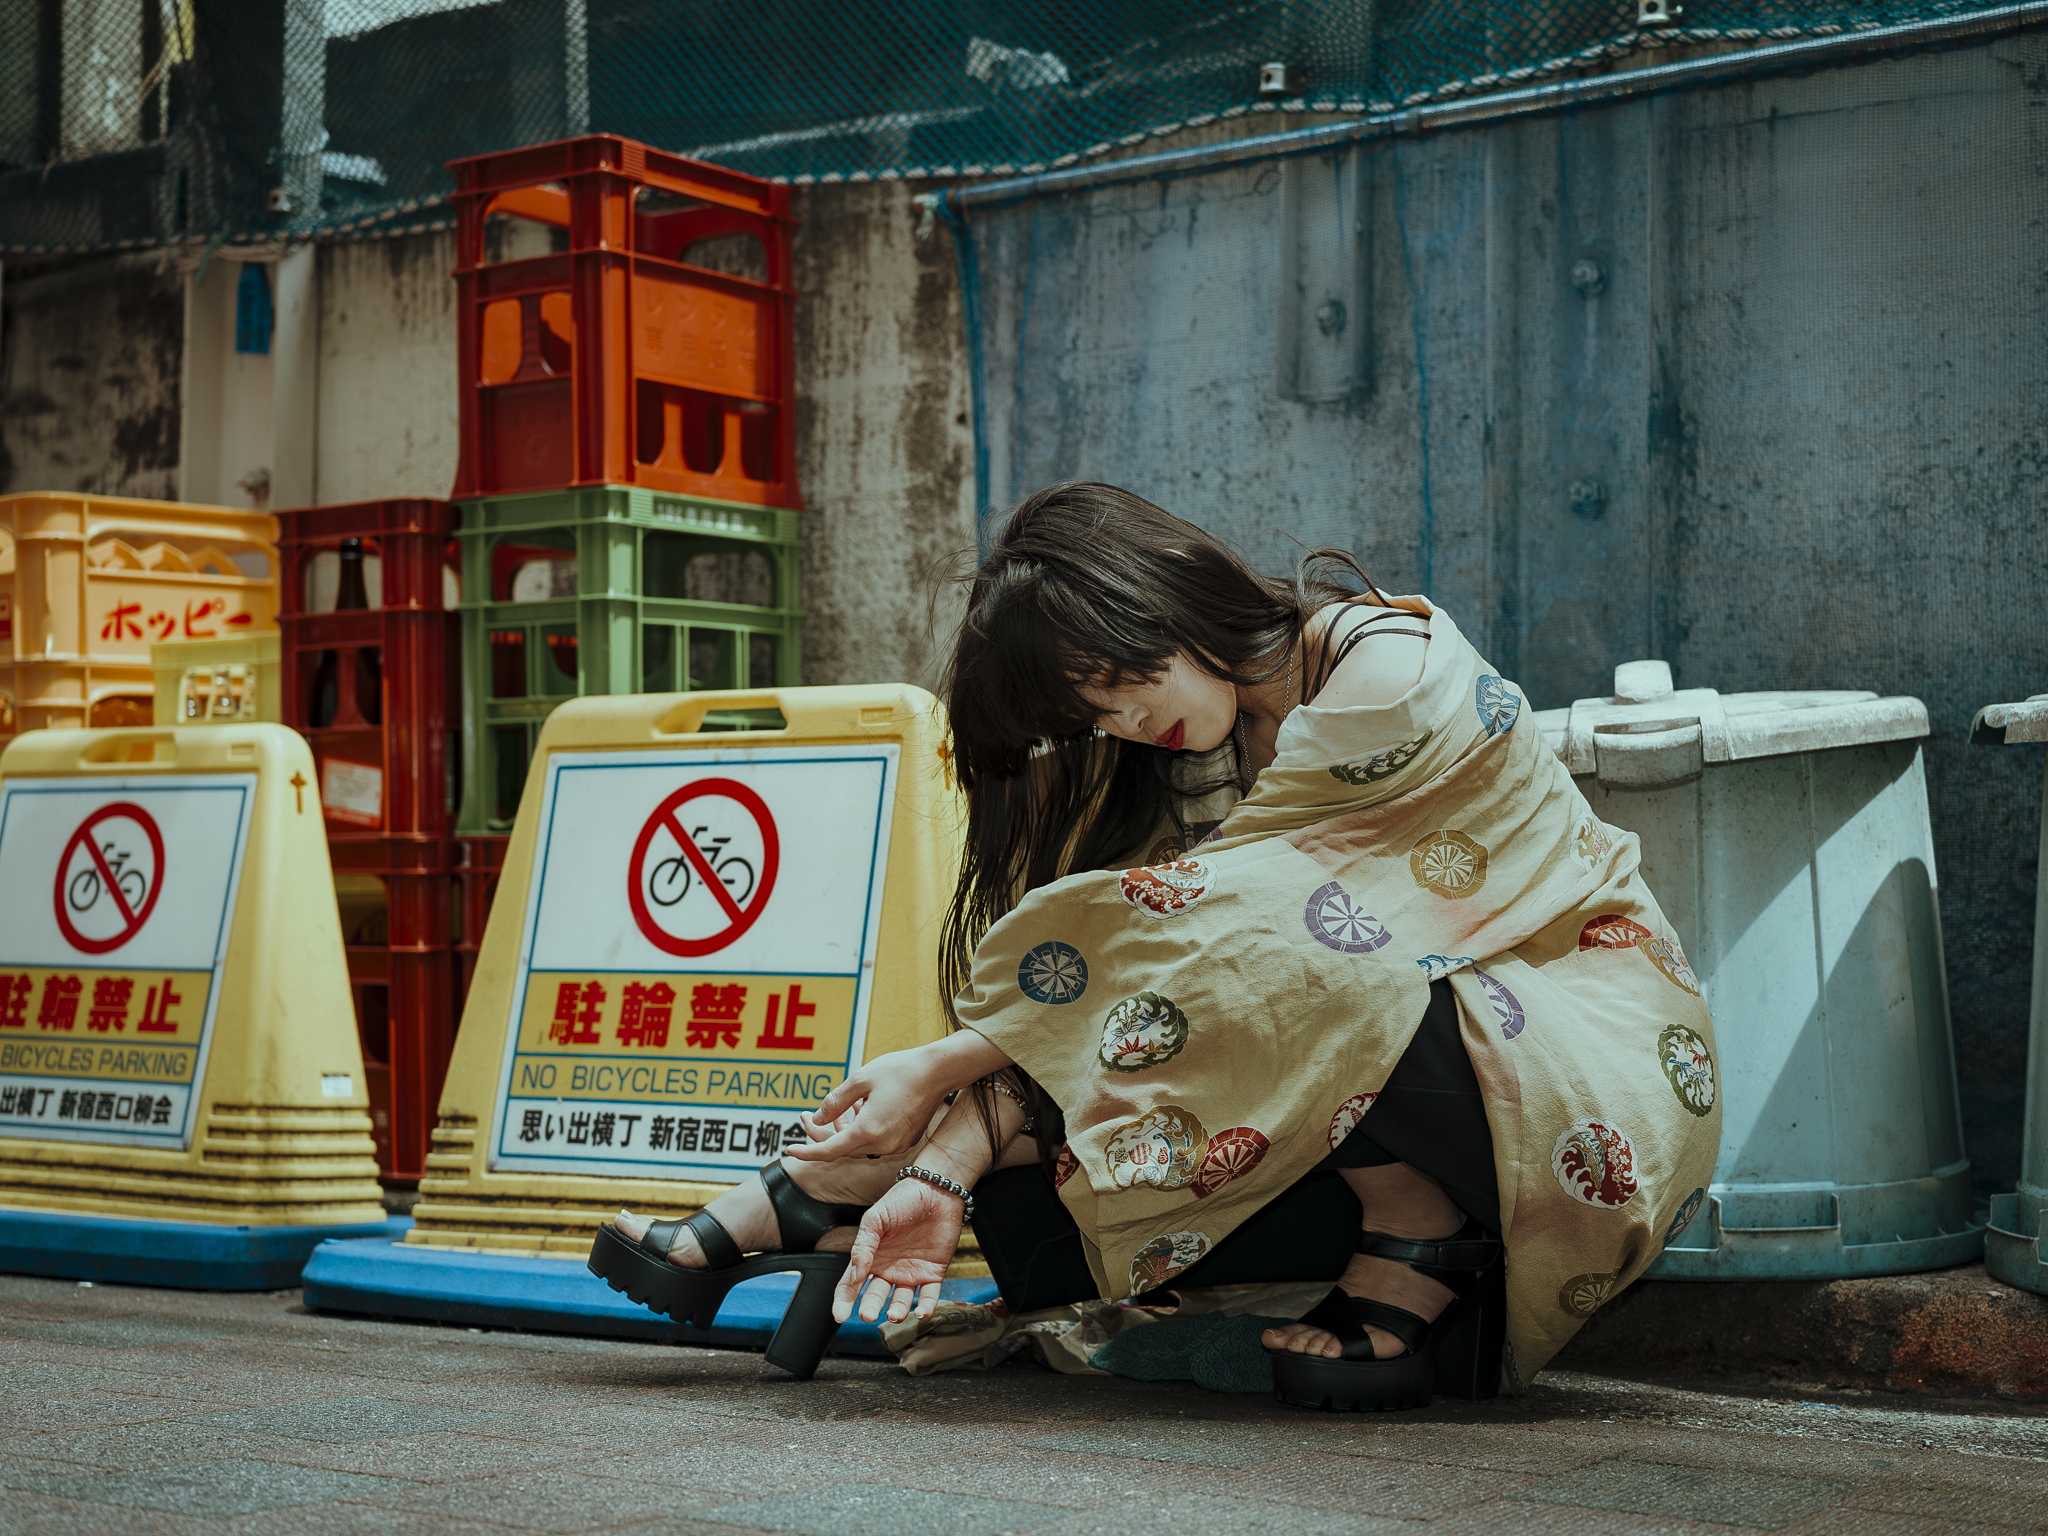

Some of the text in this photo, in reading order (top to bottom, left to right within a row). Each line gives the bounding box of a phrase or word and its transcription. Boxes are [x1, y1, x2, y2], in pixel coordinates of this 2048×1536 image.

[100, 597, 253, 640] ホッピー
[0, 973, 182, 1034] 駐輪禁止
[549, 980, 816, 1050] 駐輪禁止
[1, 1044, 188, 1077] BICYCLES PARKING
[521, 1063, 832, 1100] NO BICYCLES PARKING
[0, 1086, 173, 1126] 出横丁 新宿西口柳会
[519, 1109, 642, 1147] 思い出横丁
